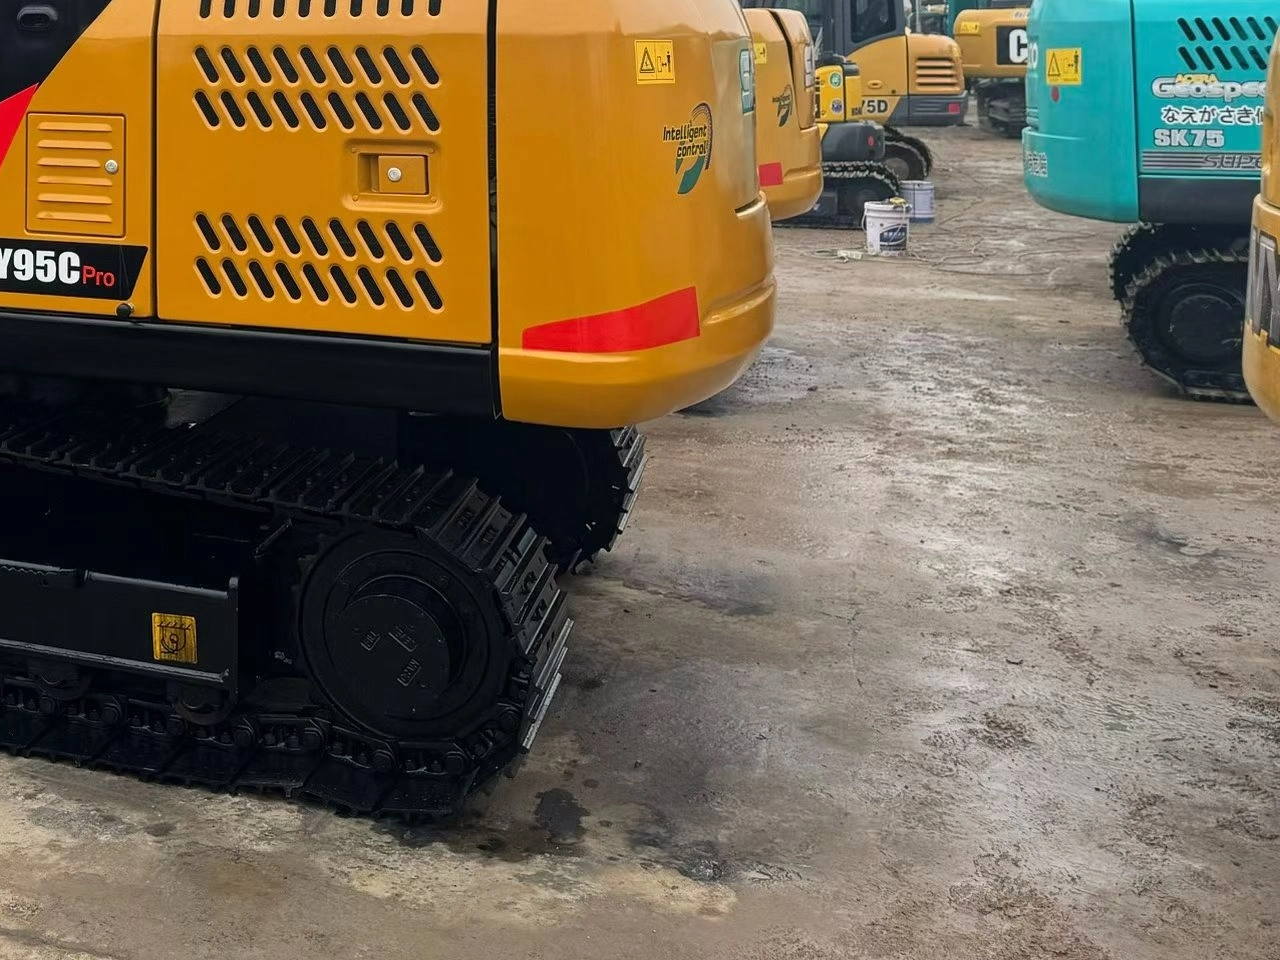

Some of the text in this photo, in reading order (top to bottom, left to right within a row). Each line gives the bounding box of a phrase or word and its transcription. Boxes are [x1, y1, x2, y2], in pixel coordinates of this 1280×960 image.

[663, 121, 707, 142] Intelligent
[677, 140, 706, 157] control
[82, 265, 115, 287] Pro
